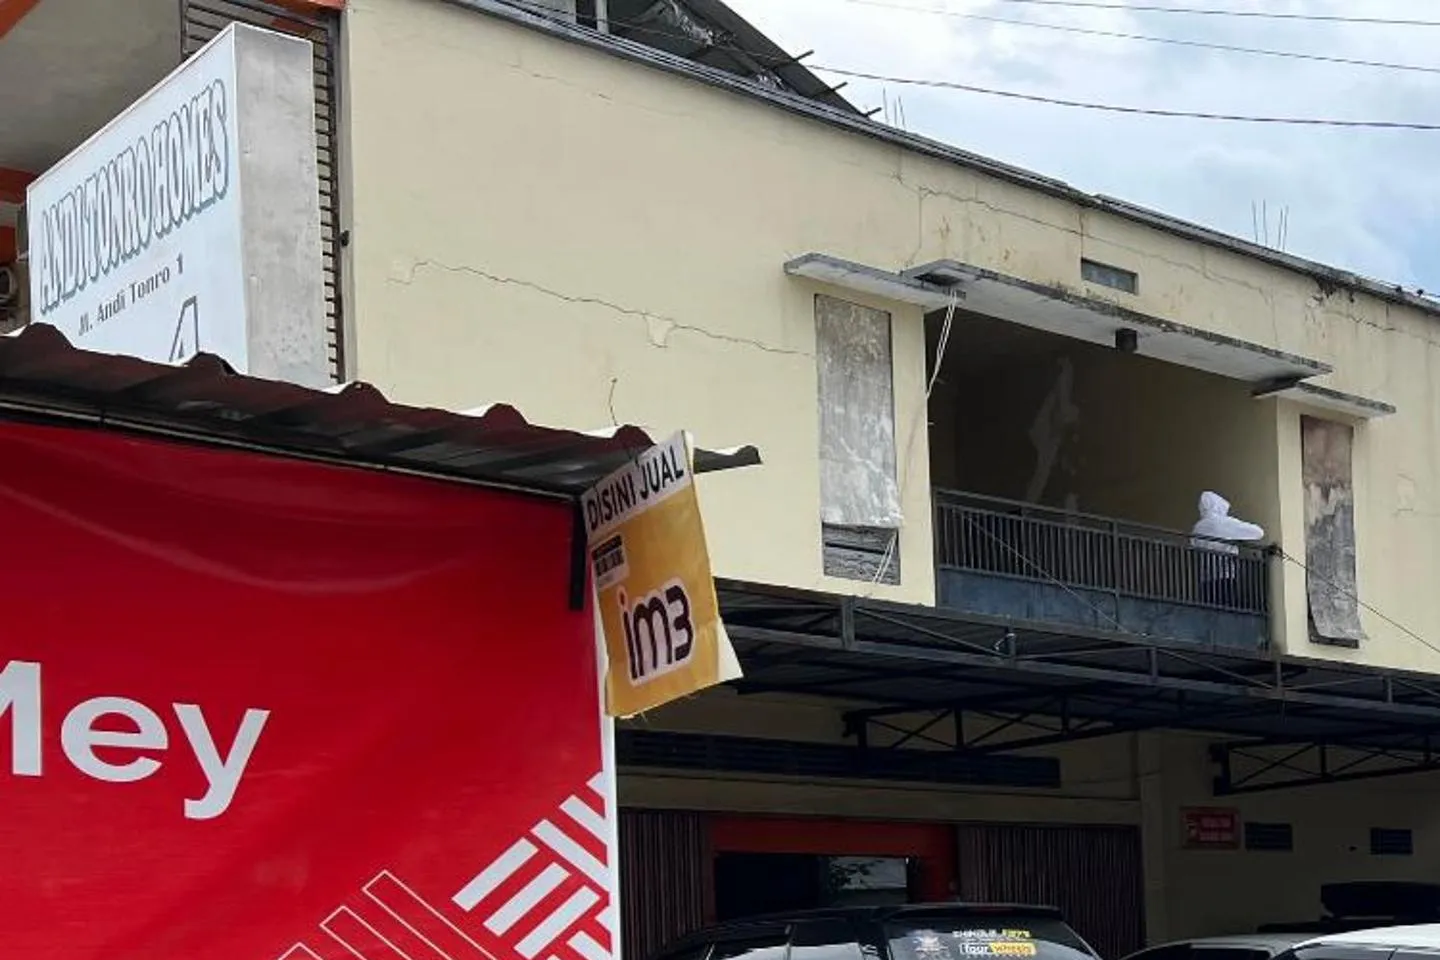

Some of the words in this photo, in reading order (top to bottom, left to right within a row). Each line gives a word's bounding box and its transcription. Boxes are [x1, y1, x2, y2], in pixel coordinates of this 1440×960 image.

[97, 289, 126, 322] Andi
[587, 472, 636, 532] DISINI
[640, 445, 685, 494] JUAL
